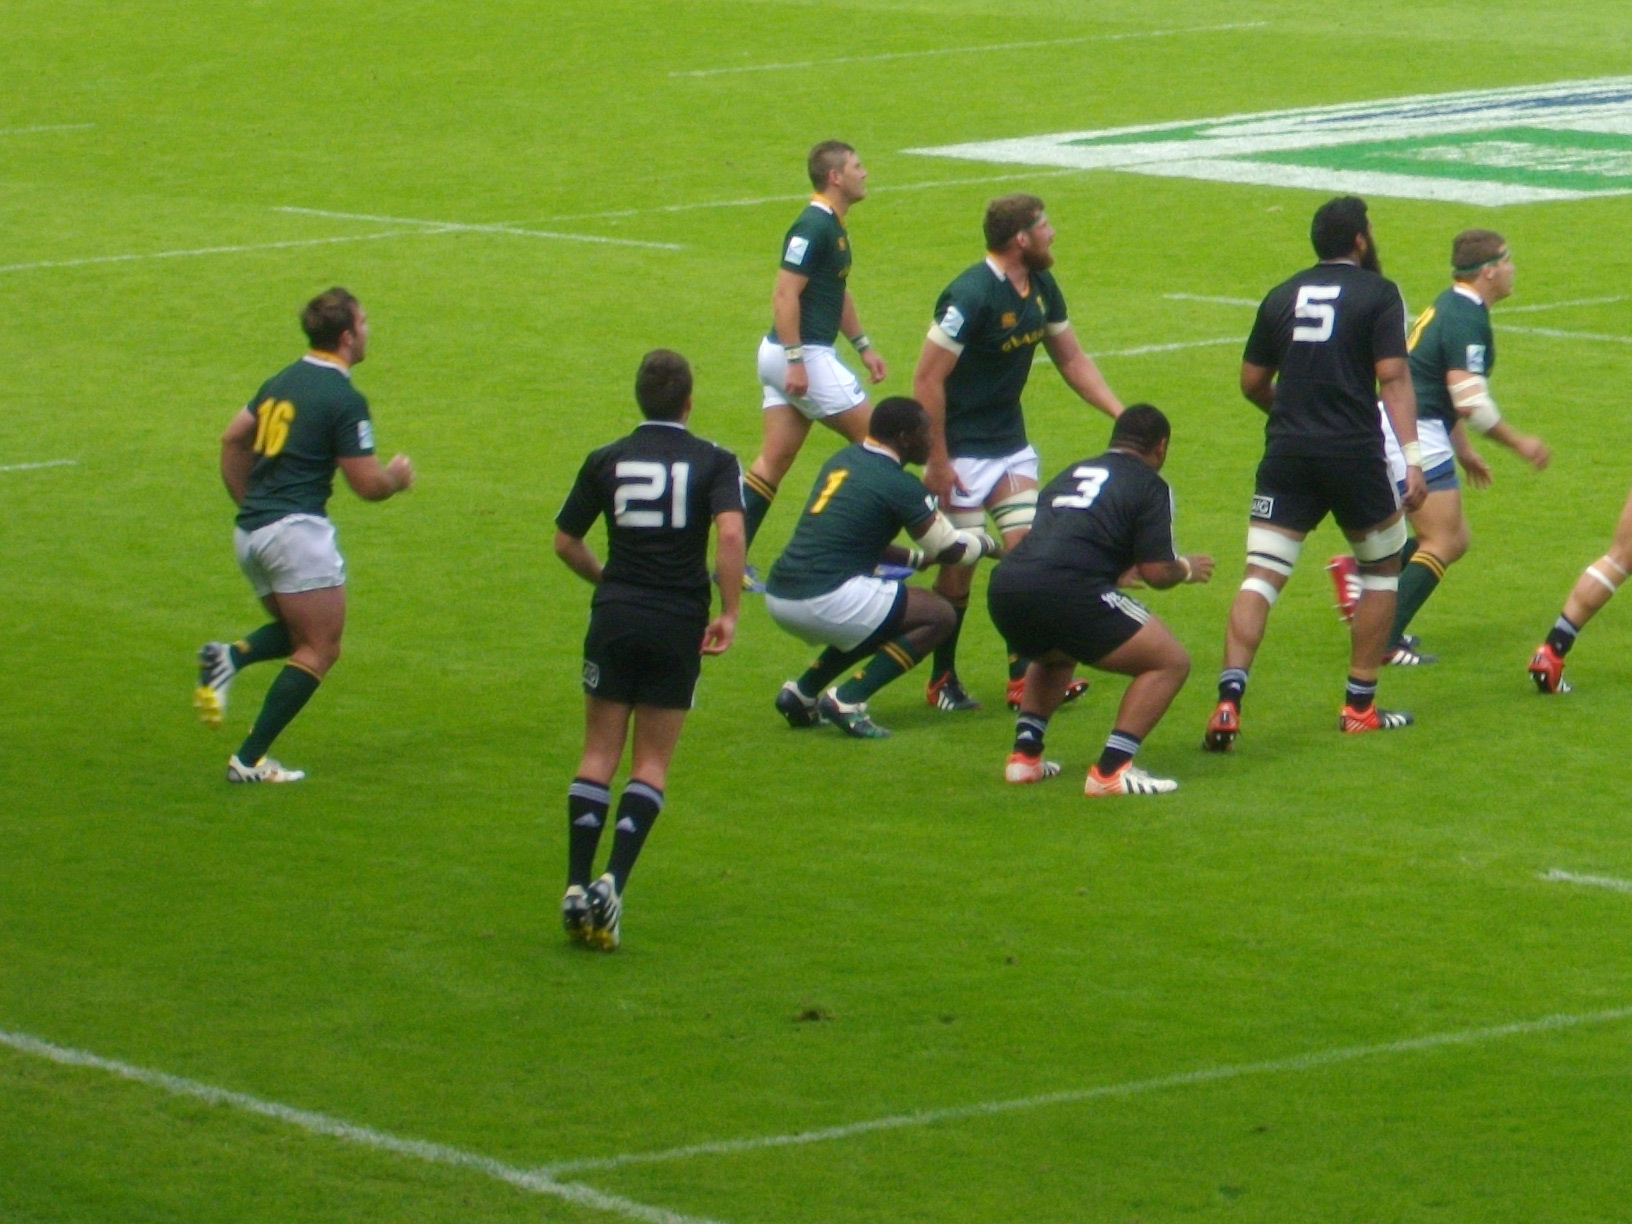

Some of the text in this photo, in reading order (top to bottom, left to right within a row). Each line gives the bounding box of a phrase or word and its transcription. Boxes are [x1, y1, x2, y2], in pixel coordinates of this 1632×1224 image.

[1292, 285, 1342, 343] 5
[253, 396, 296, 457] 16
[612, 460, 690, 529] 21
[809, 467, 849, 515] 1
[1051, 466, 1111, 510] 3
